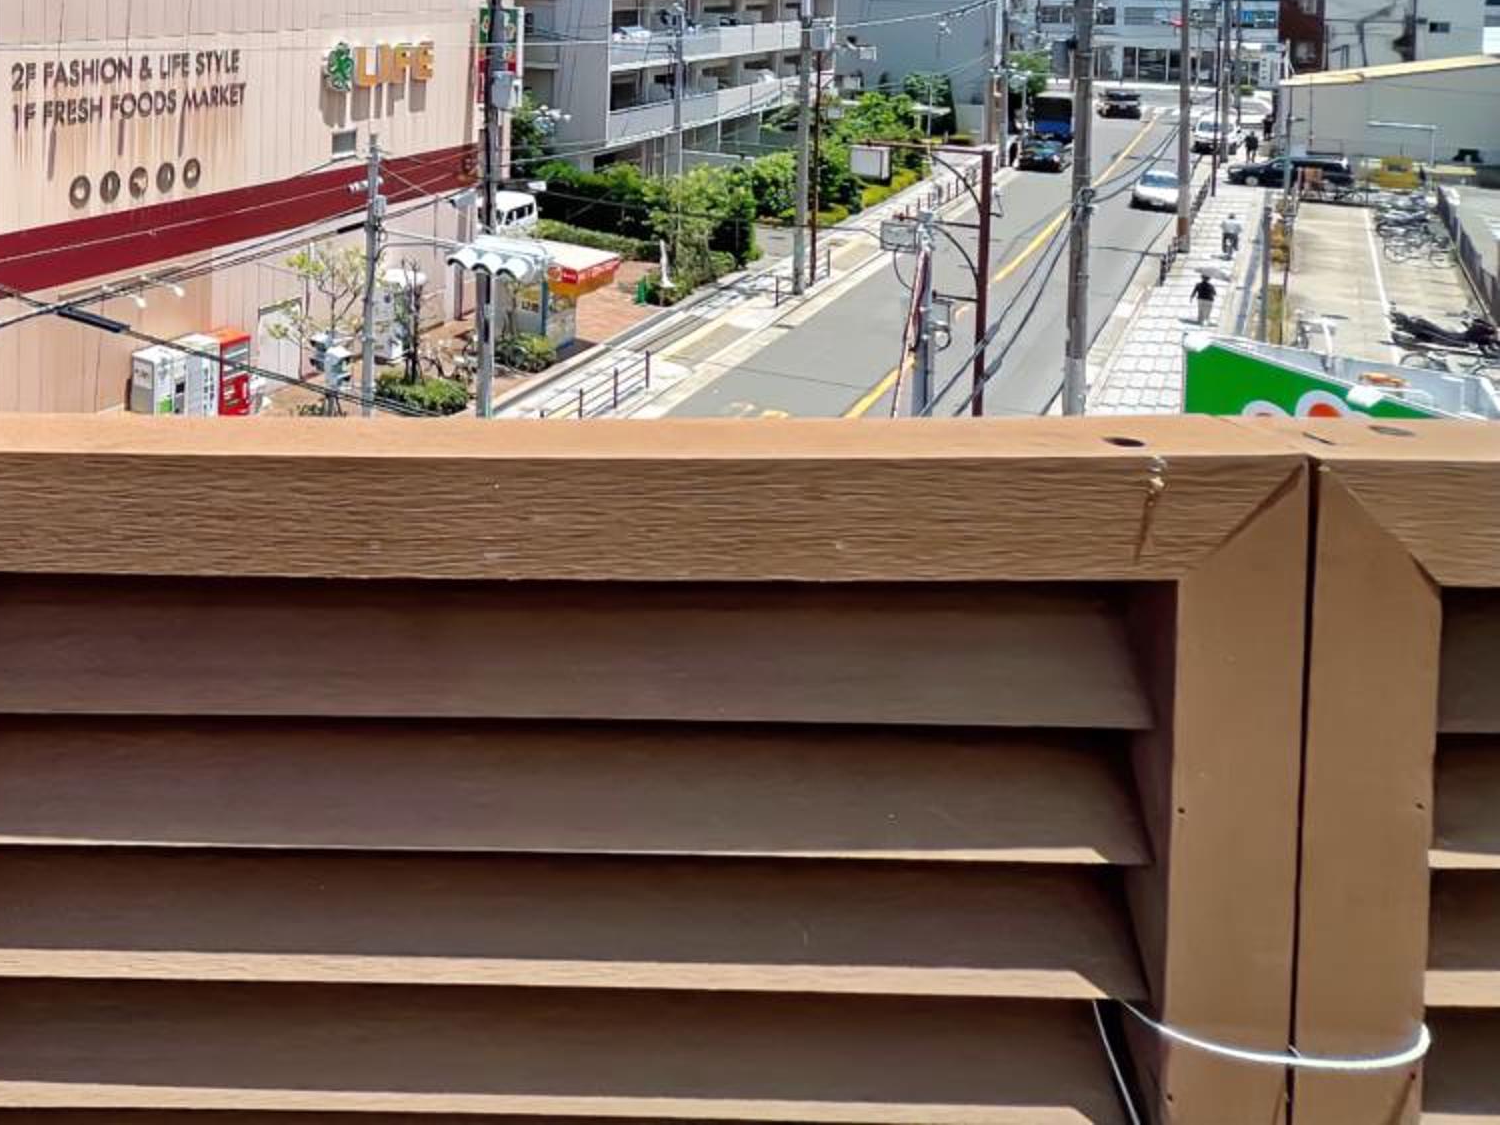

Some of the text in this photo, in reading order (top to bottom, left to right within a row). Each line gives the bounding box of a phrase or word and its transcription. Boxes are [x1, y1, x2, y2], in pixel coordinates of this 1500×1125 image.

[11, 49, 241, 91] 2F FASHION & LIFE STYLE
[353, 42, 434, 89] LIFE
[12, 82, 247, 131] 1F FRESH FOODS MARKET
